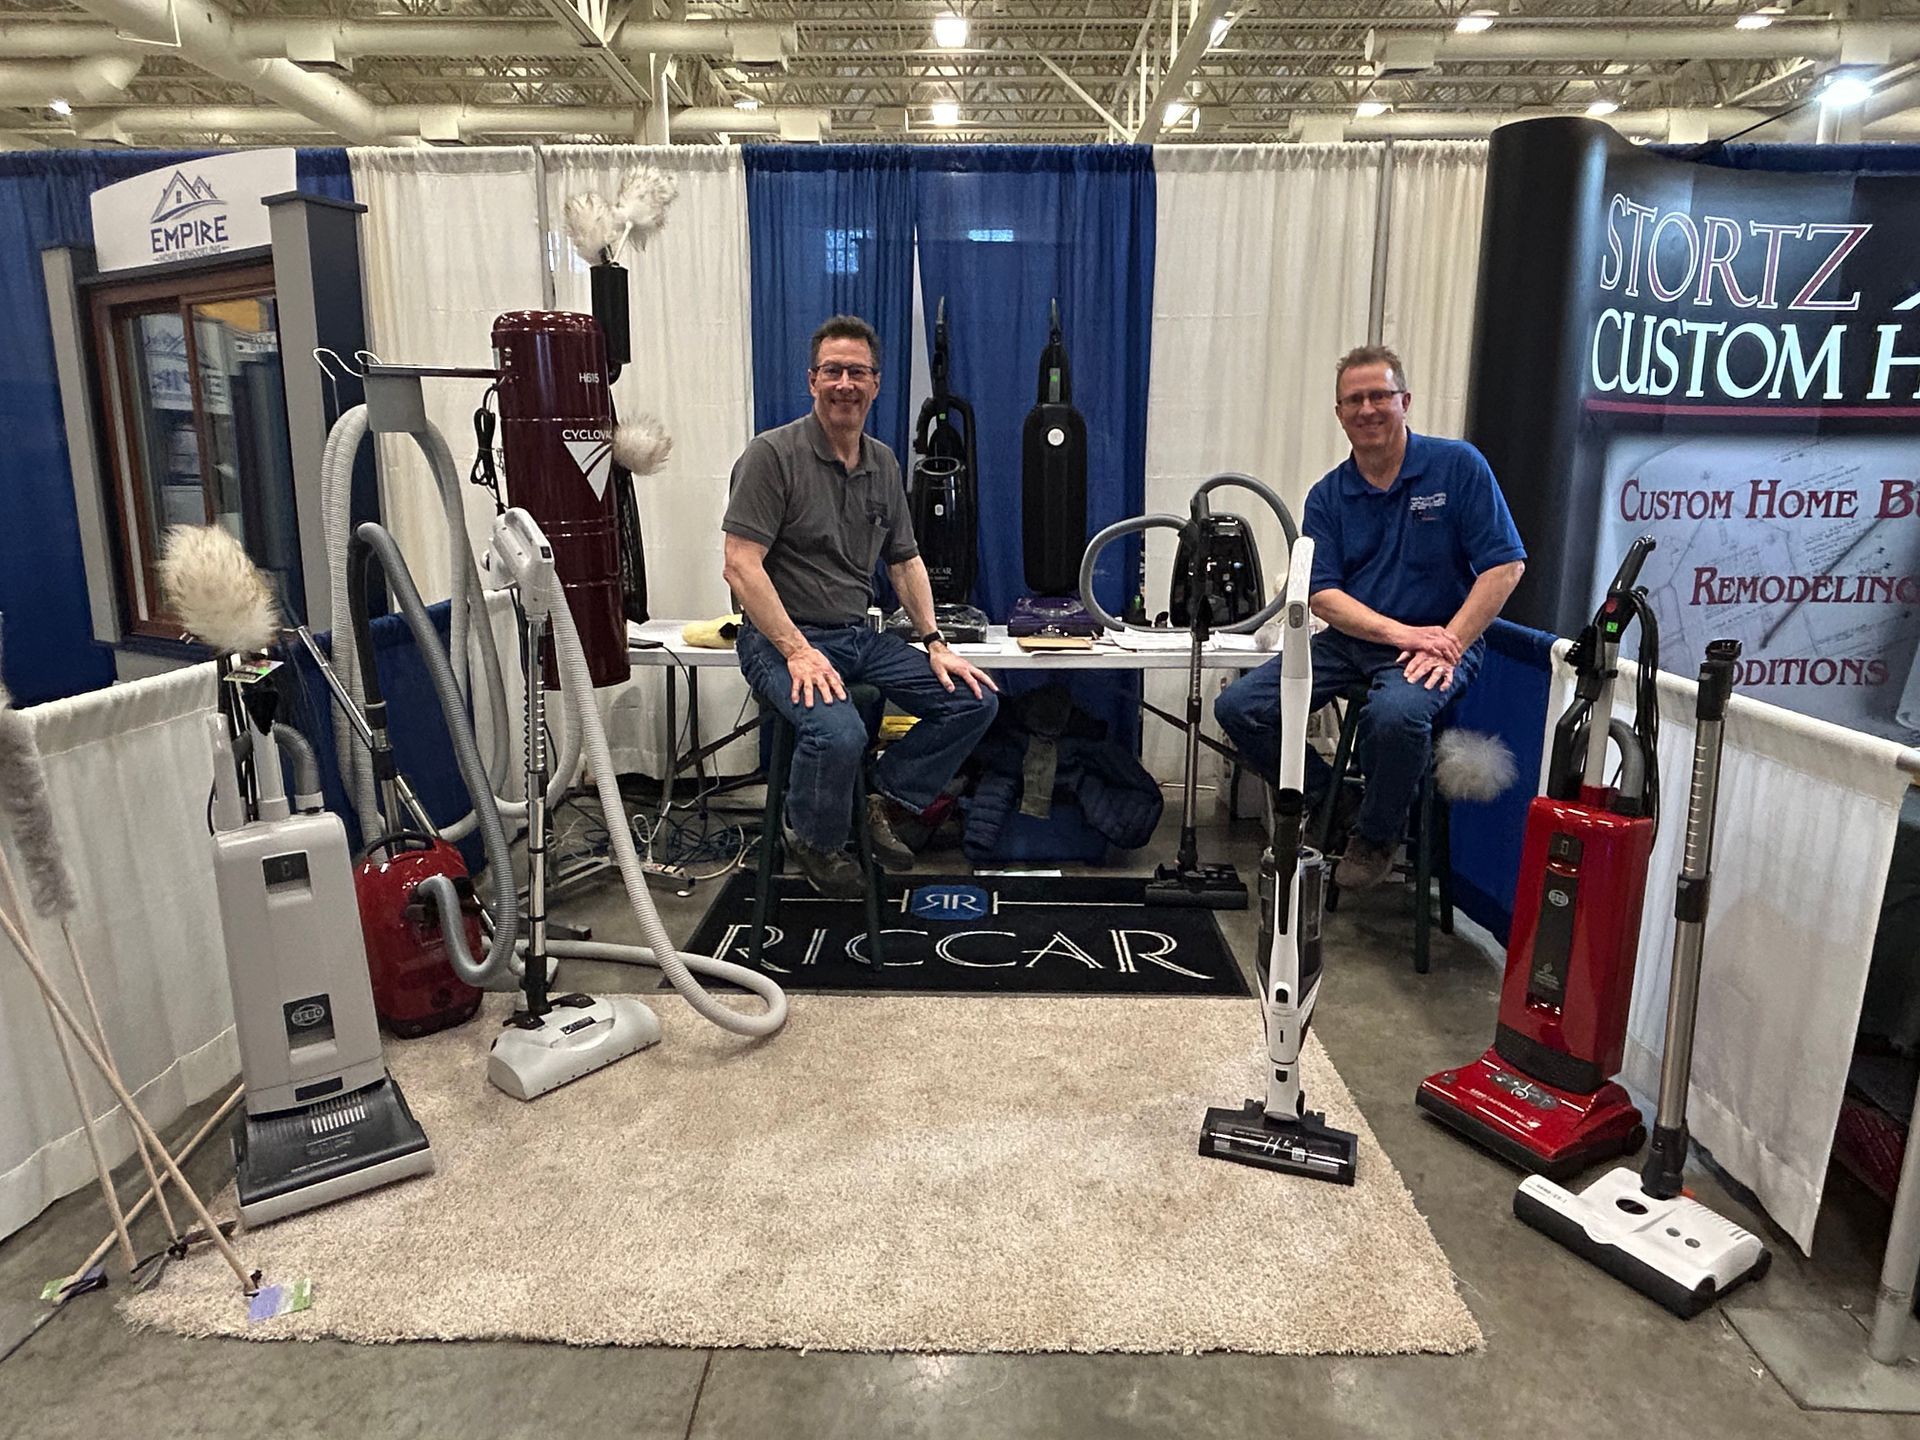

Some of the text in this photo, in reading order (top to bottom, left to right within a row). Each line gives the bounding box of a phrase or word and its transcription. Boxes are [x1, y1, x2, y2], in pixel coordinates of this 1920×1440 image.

[150, 215, 229, 254] EMPIRE
[1600, 193, 1873, 311] STORTZ
[1592, 308, 1847, 400] CUSTOM
[578, 372, 600, 384] H615
[1620, 478, 1735, 522] CUSTOM
[1745, 479, 1859, 519] HOME
[1874, 479, 1920, 519] B
[1733, 658, 1890, 686] DDITIONS
[712, 923, 1215, 980] RICCAR
[293, 1008, 323, 1022] SEBO
